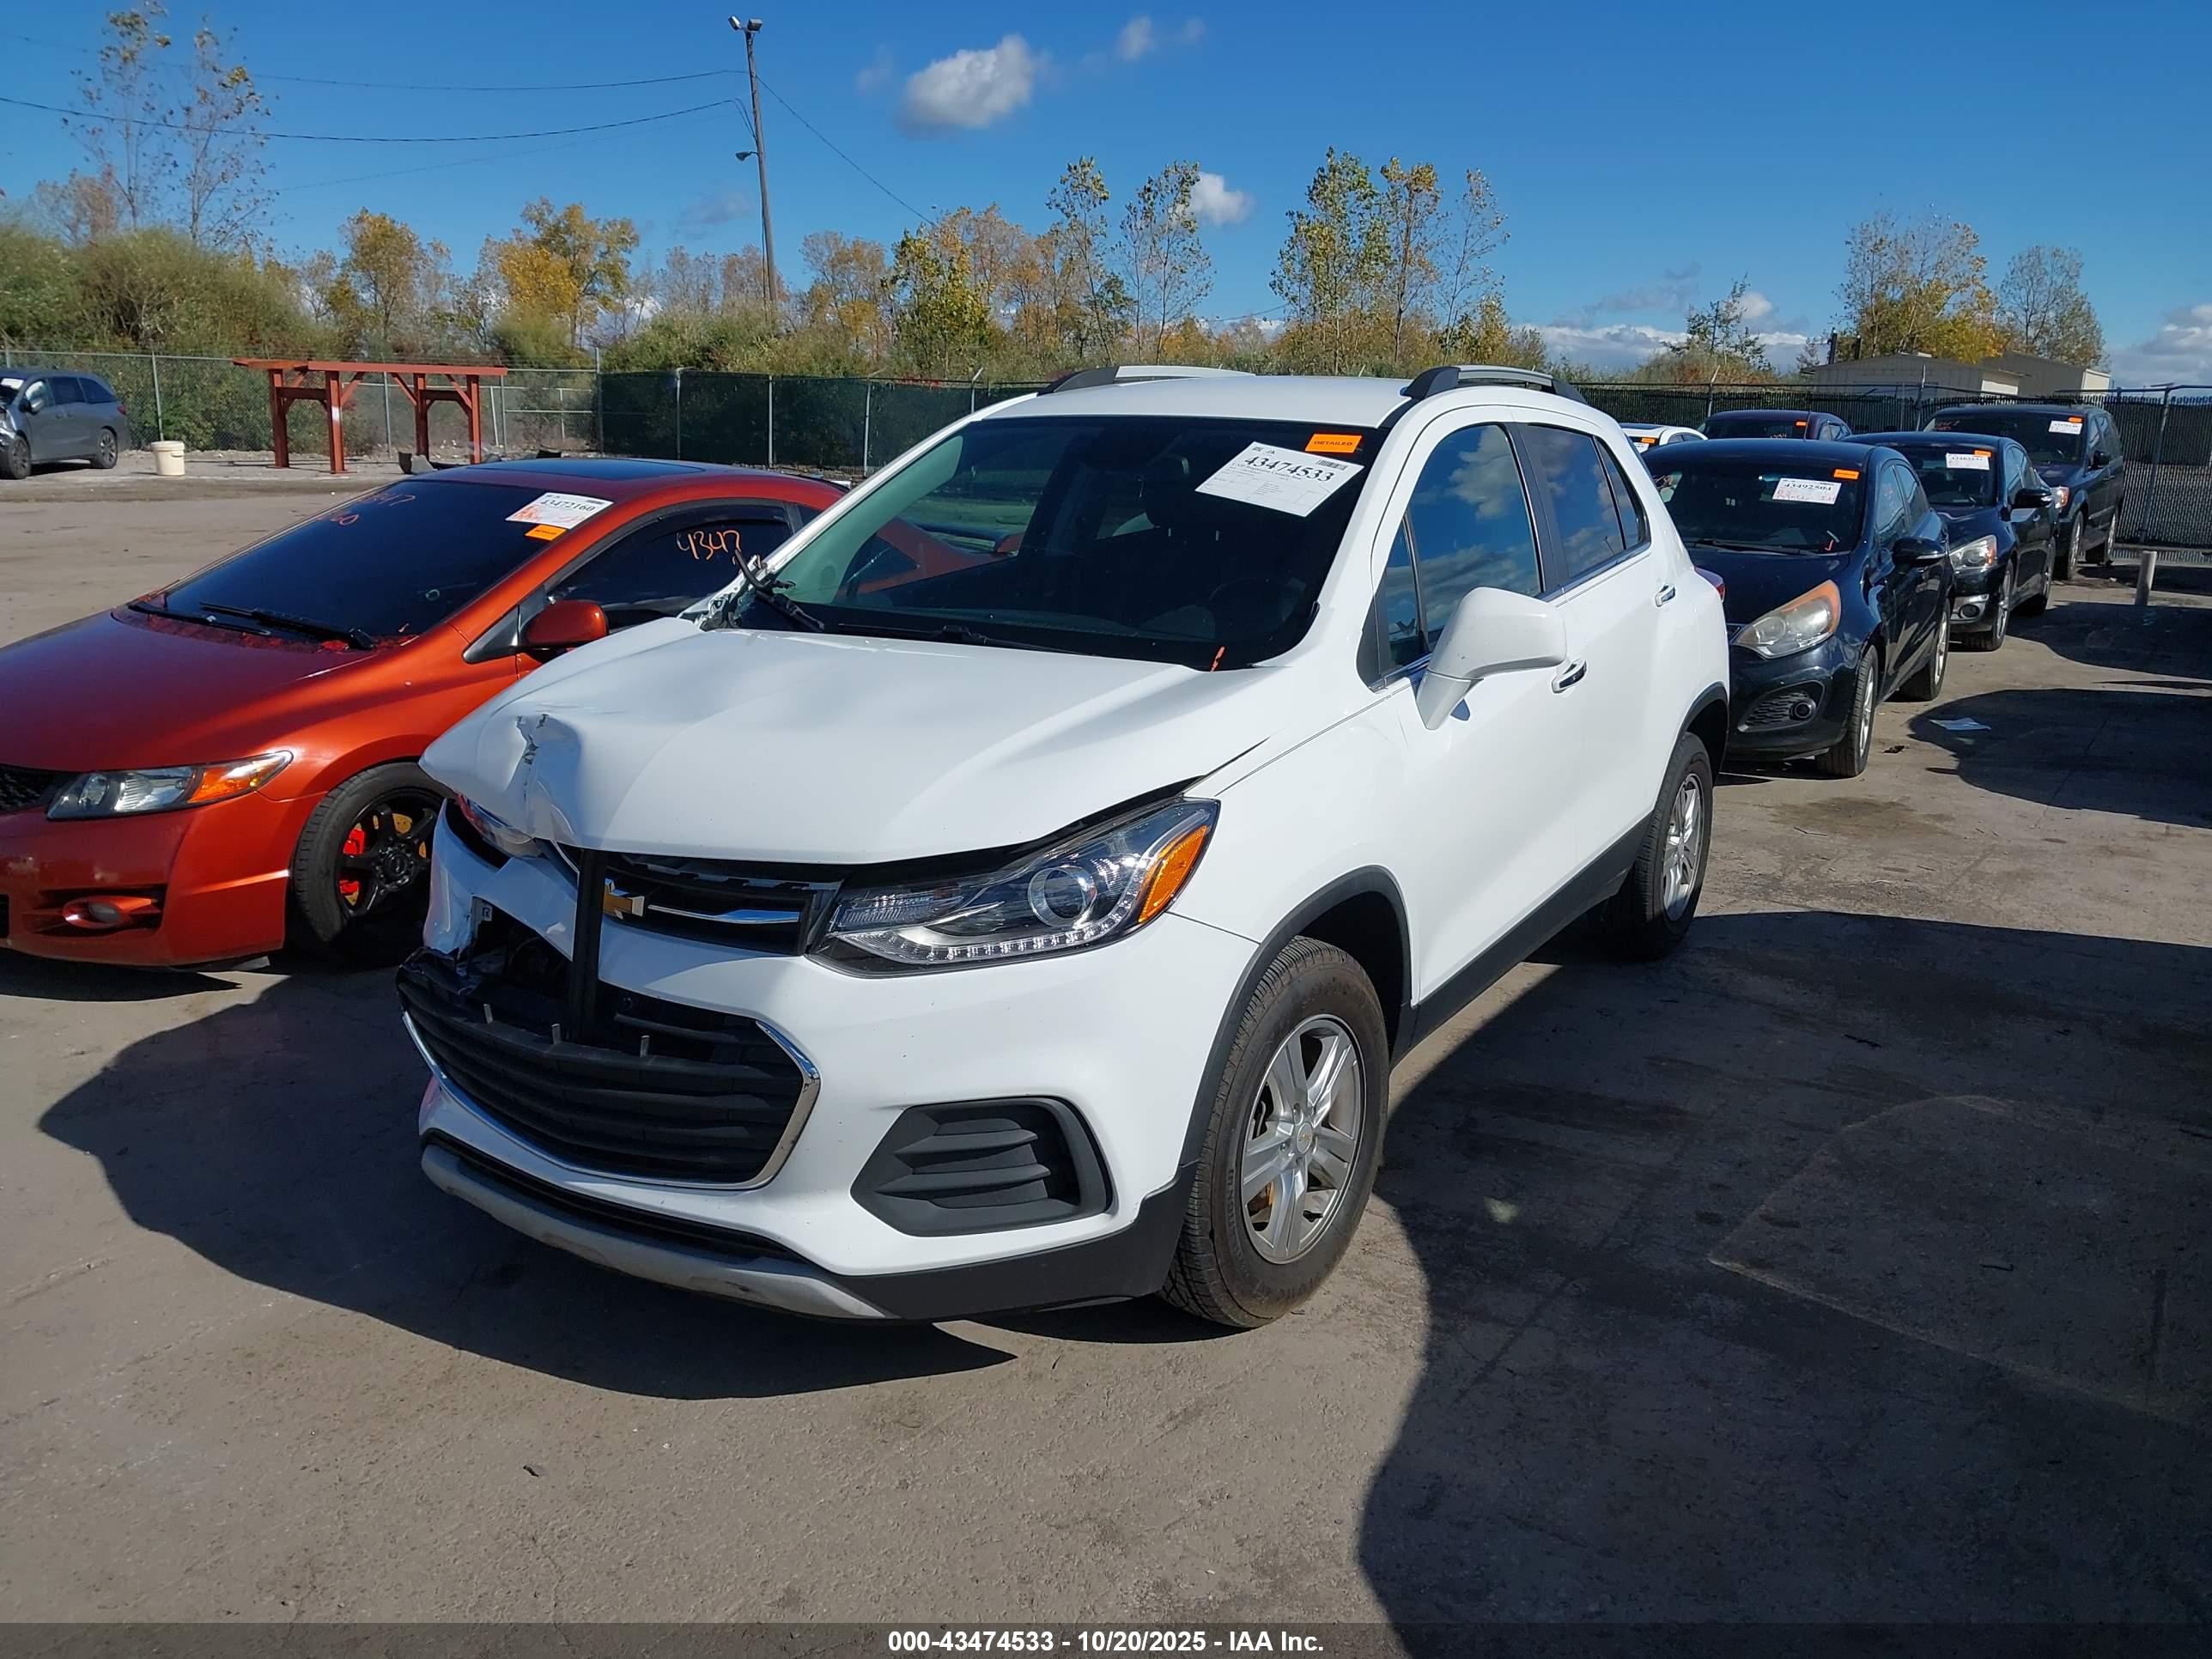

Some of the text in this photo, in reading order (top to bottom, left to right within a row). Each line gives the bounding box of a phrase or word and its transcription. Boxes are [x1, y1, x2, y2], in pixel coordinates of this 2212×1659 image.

[1244, 456, 1335, 482] 43474533
[541, 500, 596, 512] 43472160
[677, 530, 742, 561] 4347
